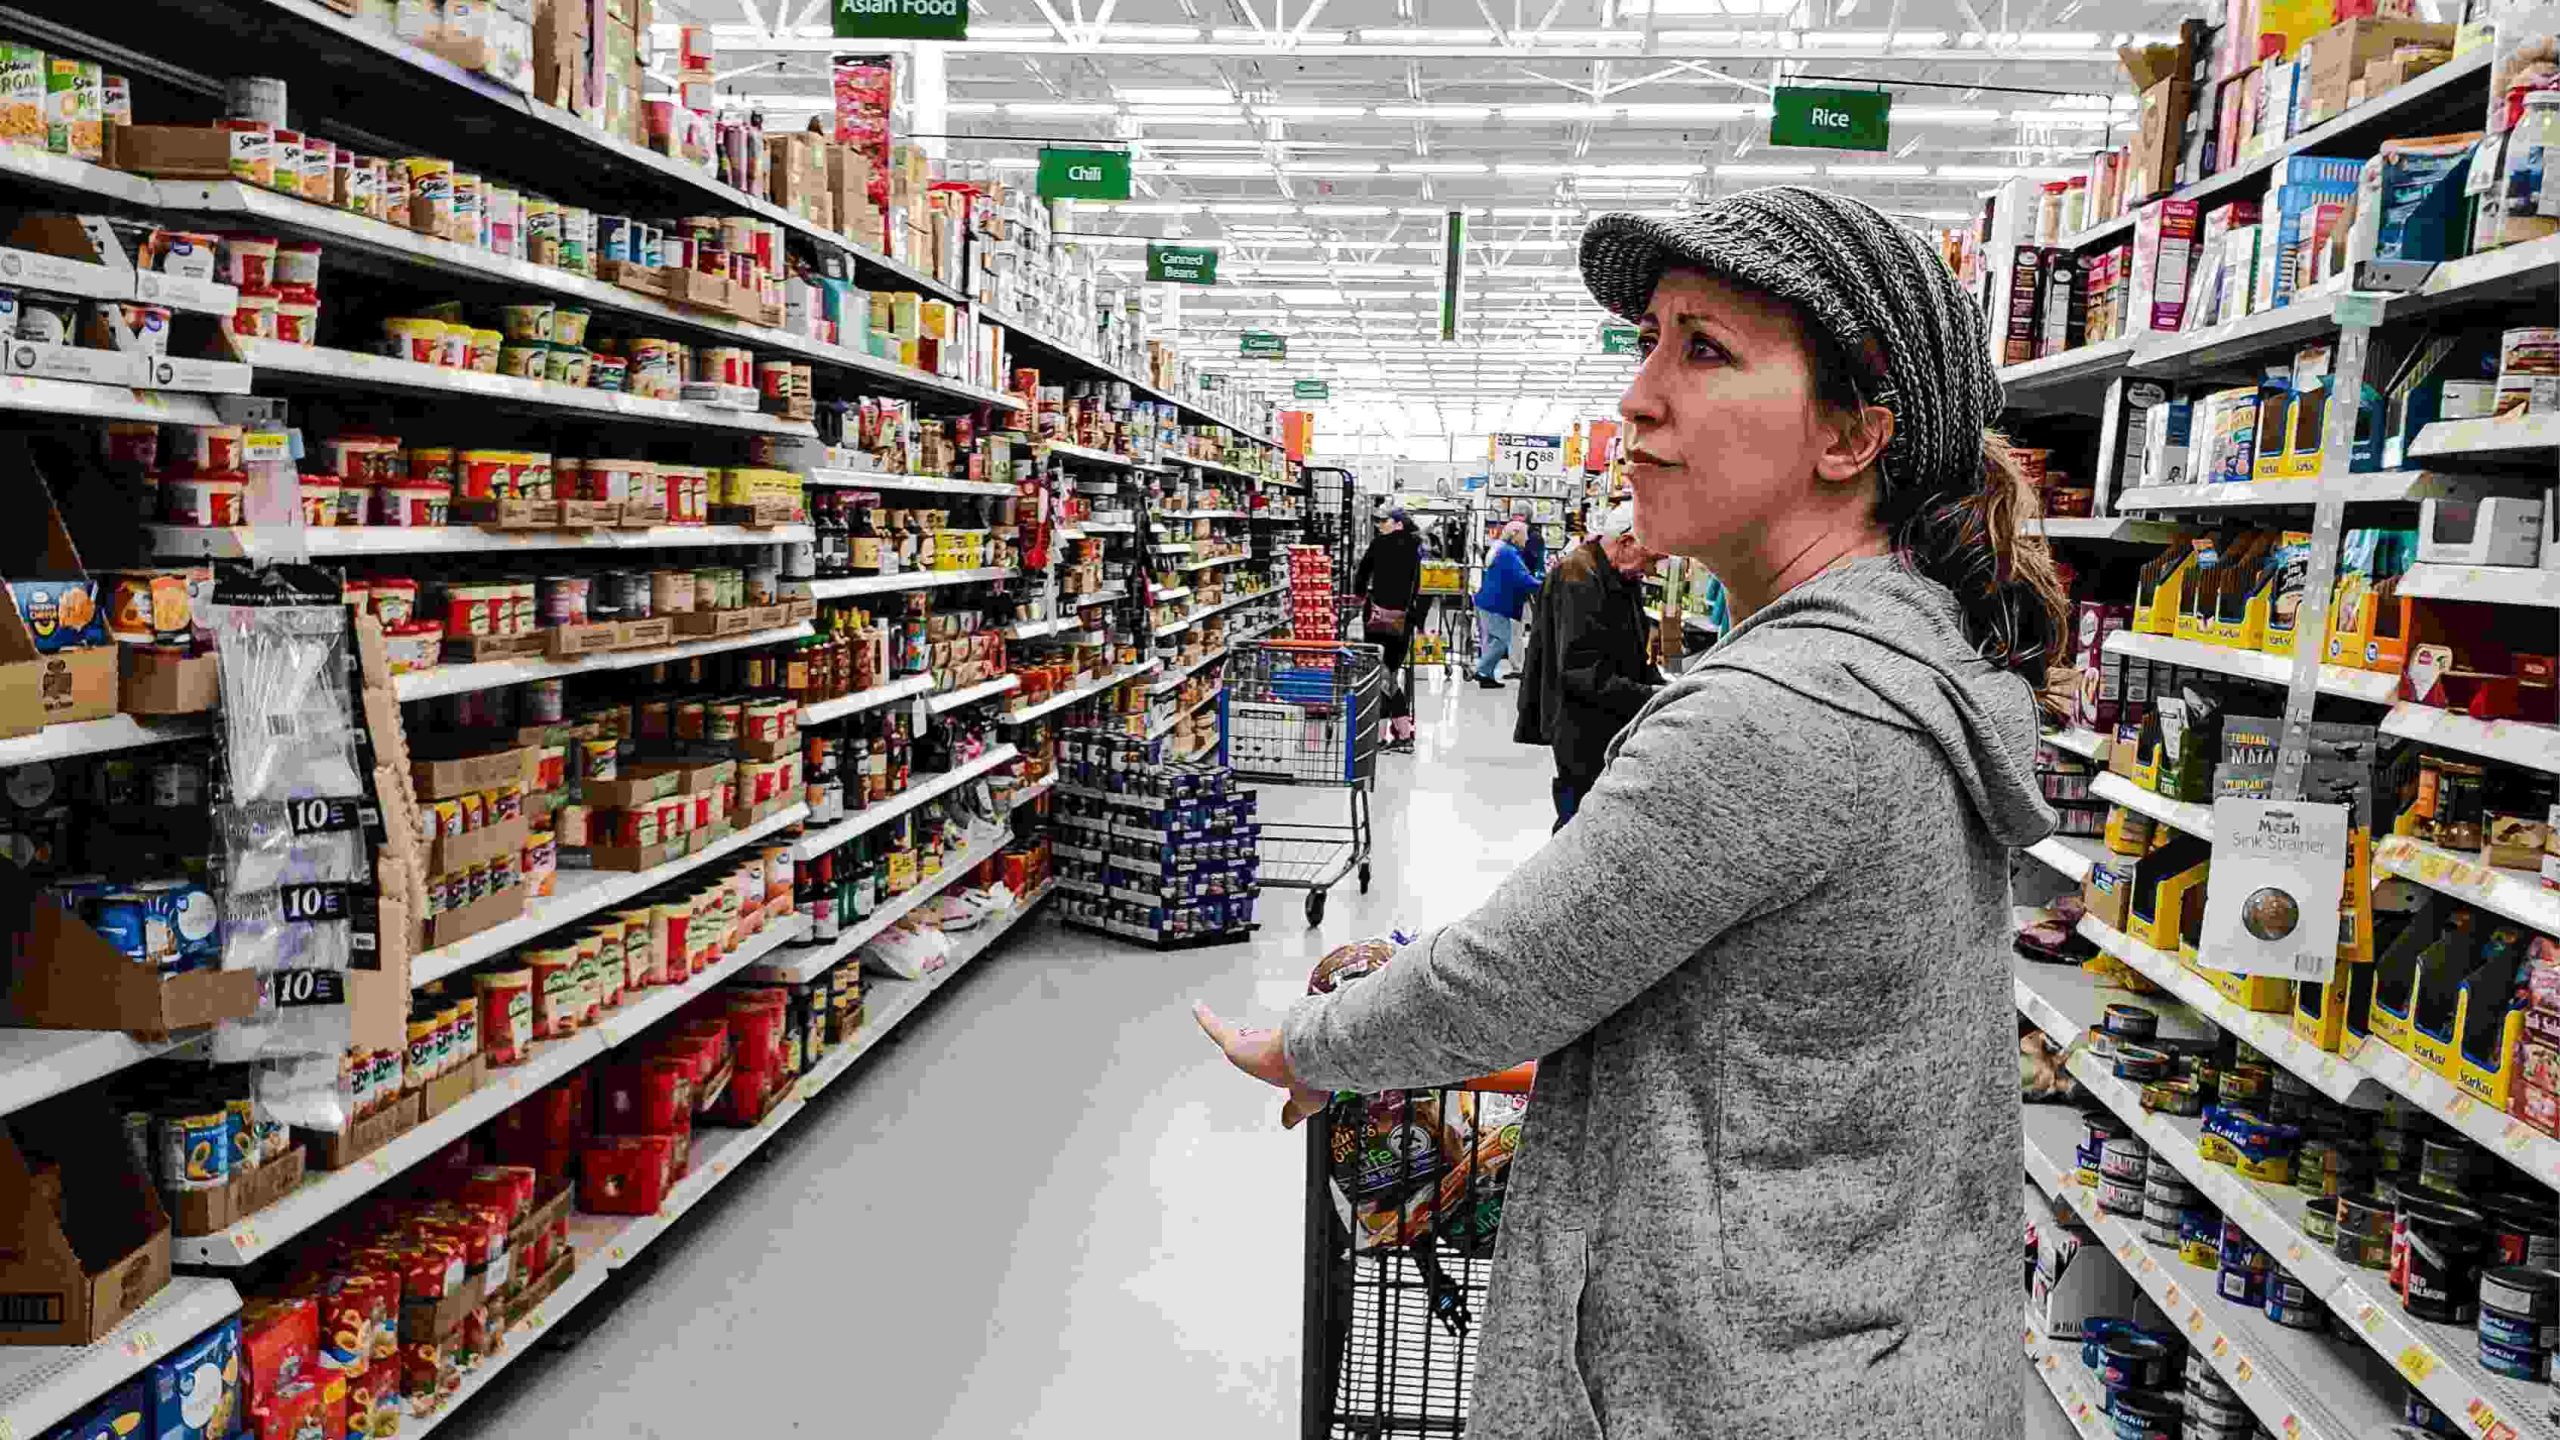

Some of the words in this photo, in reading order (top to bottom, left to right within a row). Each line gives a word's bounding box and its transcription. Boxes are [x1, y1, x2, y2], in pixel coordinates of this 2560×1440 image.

[841, 0, 898, 13] Asian
[904, 0, 957, 15] Food
[1811, 107, 1850, 127] Rice
[1068, 166, 1102, 181] Chili
[1160, 252, 1204, 265] Canned
[1164, 266, 1199, 279] Beans
[297, 800, 329, 830] 10
[2258, 819, 2301, 836] Mesh
[2233, 830, 2262, 848] Sink
[2268, 833, 2325, 854] Strainer
[290, 887, 322, 918] 10
[281, 971, 315, 1001] 10
